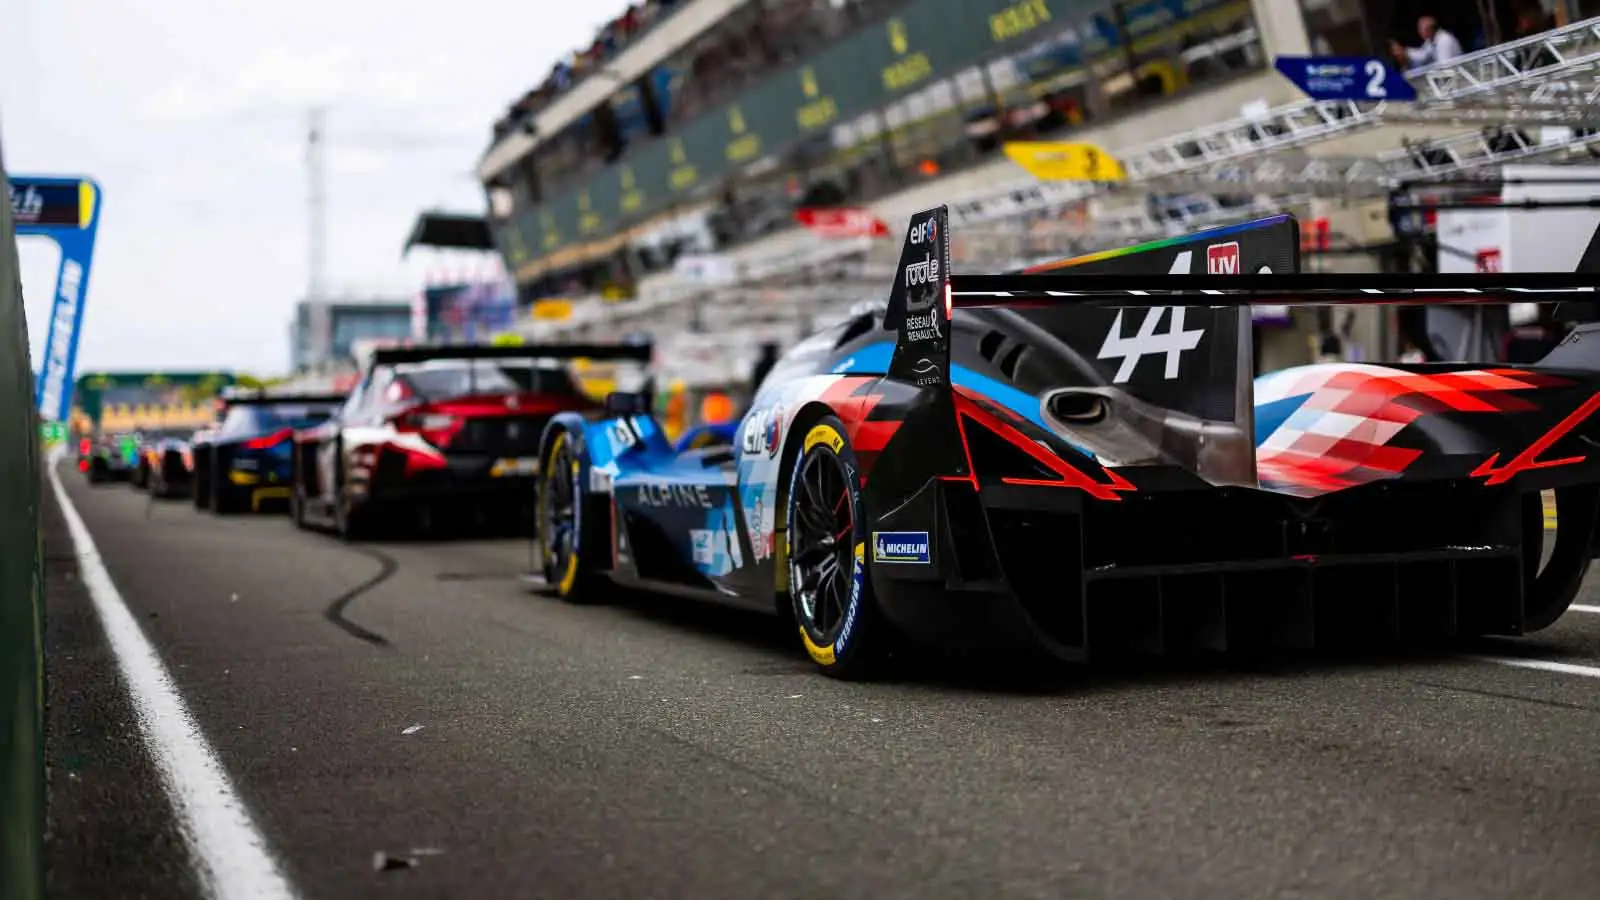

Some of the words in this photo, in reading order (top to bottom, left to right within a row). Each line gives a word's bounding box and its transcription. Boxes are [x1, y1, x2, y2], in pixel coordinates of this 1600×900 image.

[1364, 60, 1387, 97] 2
[910, 223, 927, 244] elf
[906, 314, 930, 329] RÉSEAU
[907, 328, 936, 341] RENAULT
[743, 409, 769, 454] elf
[638, 480, 713, 508] ALPINE
[886, 543, 927, 554] MICHELIN
